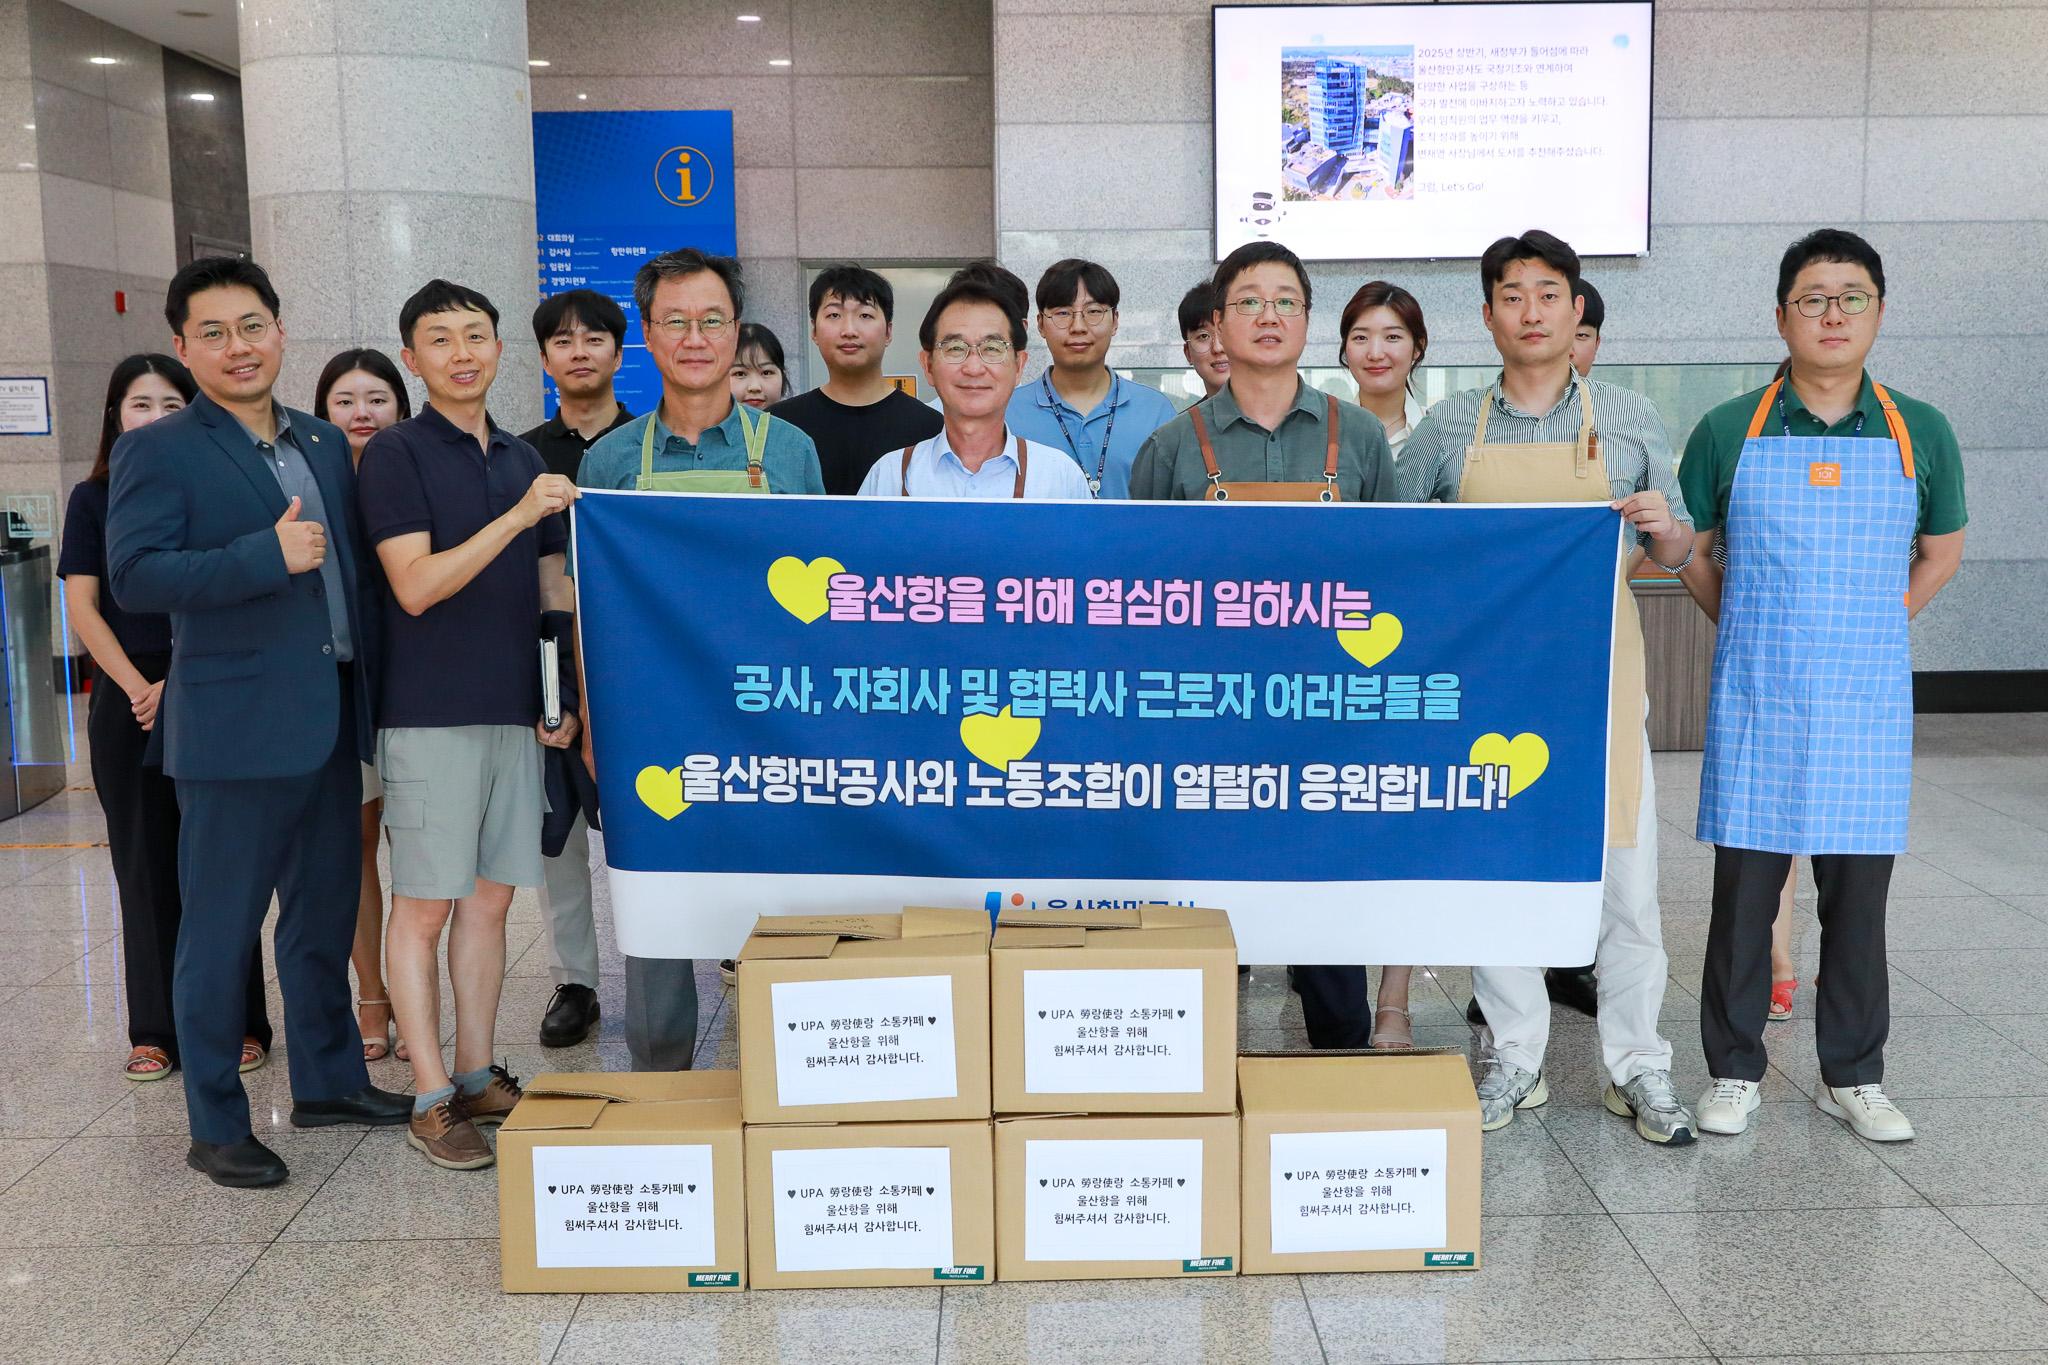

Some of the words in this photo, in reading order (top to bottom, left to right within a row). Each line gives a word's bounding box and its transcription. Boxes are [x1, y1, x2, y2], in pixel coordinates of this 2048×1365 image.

[1418, 48, 1453, 58] 2025년
[1570, 46, 1589, 56] 따라
[828, 573, 986, 623] 울산항을
[995, 577, 1074, 625] 위해
[1084, 579, 1202, 626] 열심히
[1213, 581, 1372, 629] 일하시는
[733, 665, 822, 715] 공사,
[832, 666, 951, 715] 자회사
[961, 669, 999, 716] 및
[1009, 669, 1127, 717] 협력사
[1136, 671, 1255, 719] 근로자
[1265, 672, 1461, 721] 여러분들을
[681, 754, 957, 806] 울산항만공사와
[965, 760, 1162, 809] 노동조합이
[1173, 763, 1289, 810] 열렬히
[1299, 763, 1509, 811] 응원합니다!
[1052, 1010, 1074, 1019] UPA
[1130, 1009, 1173, 1020] 소통카페
[801, 1021, 824, 1031] UPA
[881, 1016, 923, 1027] 소통카페
[1078, 1026, 1120, 1038] 울산항을
[1127, 1027, 1147, 1038] 위해
[828, 1036, 871, 1049] 울산항을
[878, 1035, 898, 1046] 위해
[1054, 1045, 1107, 1056] 힘써주셔서
[1114, 1045, 1171, 1056] 감사합니다.
[806, 1055, 859, 1068] 힘써주셔서
[866, 1052, 923, 1065] 감사합니다.
[1297, 1171, 1319, 1180] UPA
[1375, 1167, 1416, 1178] 소통카페
[1053, 1179, 1075, 1188] UPA
[1130, 1177, 1172, 1188] 소통카페
[561, 1185, 584, 1194] UPA
[640, 1184, 683, 1195] 소통카페
[801, 1188, 823, 1198] UPA
[880, 1185, 922, 1196] 소통카페
[1323, 1186, 1364, 1198] 울산항을
[1371, 1186, 1391, 1196] 위해
[1077, 1195, 1119, 1206] 울산항을
[1126, 1195, 1147, 1206] 위해
[587, 1201, 631, 1213] 울산항을
[637, 1201, 658, 1212] 위해
[827, 1204, 869, 1216] 울산항을
[876, 1203, 897, 1214] 위해
[1301, 1204, 1351, 1216] 힘써주셔서
[1359, 1203, 1414, 1214] 감사합니다.
[1055, 1213, 1106, 1224] 힘써주셔서
[1114, 1213, 1169, 1224] 감사합니다.
[565, 1220, 618, 1231] 힘써주셔서
[625, 1219, 682, 1230] 감사합니다.
[804, 1223, 857, 1235] 힘써주셔서
[865, 1221, 921, 1232] 감사합니다.
[941, 1266, 963, 1274] MERRY
[695, 1274, 718, 1282] MERRY
